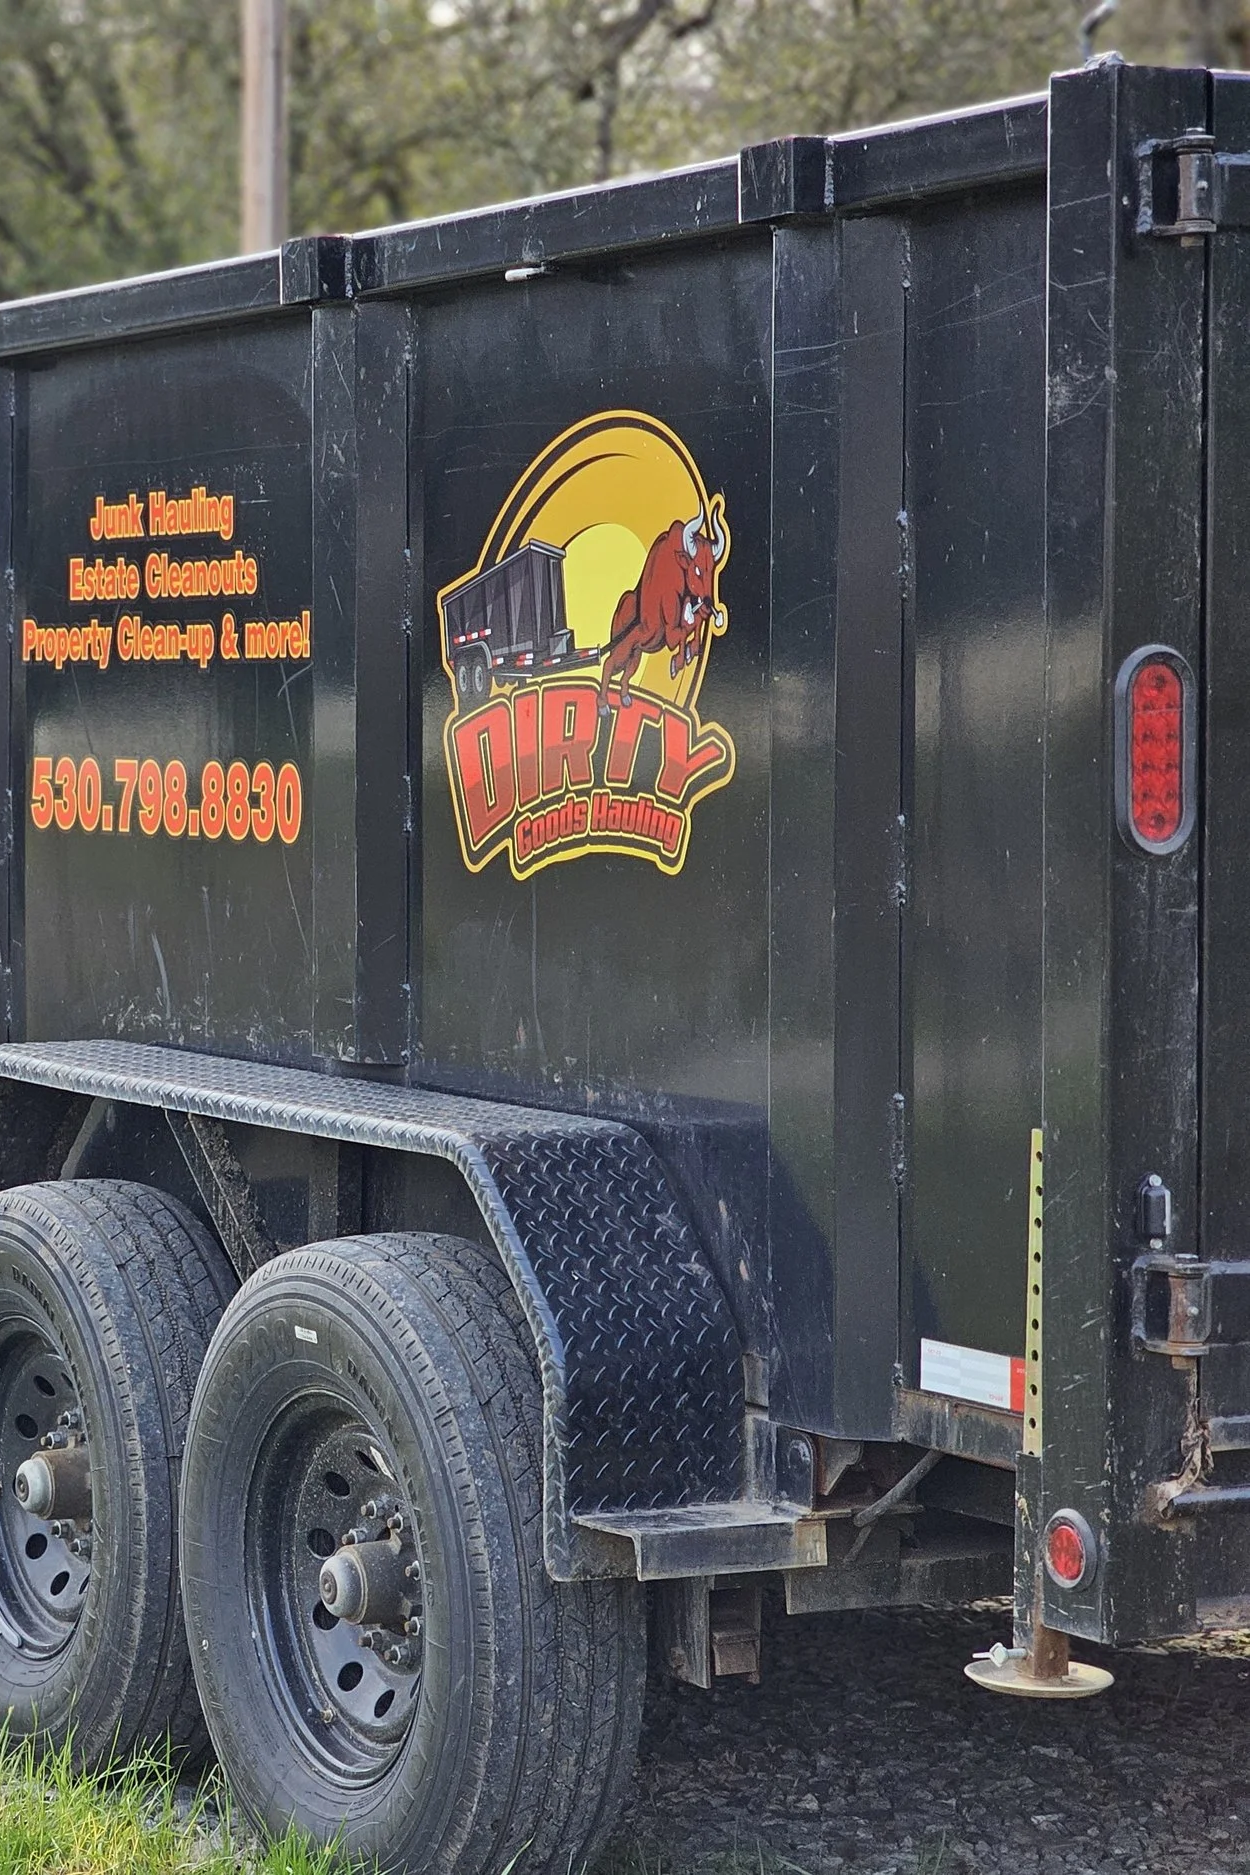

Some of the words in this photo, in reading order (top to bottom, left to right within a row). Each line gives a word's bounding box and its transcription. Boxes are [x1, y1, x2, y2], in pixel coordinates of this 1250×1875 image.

[90, 495, 144, 540] Junk
[148, 487, 234, 540] Hauling
[69, 557, 140, 601] Estate
[145, 551, 258, 599] Cleanouts
[22, 619, 113, 670] Property
[117, 615, 215, 668] Clean-up
[221, 613, 240, 659] &
[245, 610, 311, 659] more!
[453, 682, 723, 848] DIRTY
[31, 757, 302, 844] 530.798.8830
[516, 794, 588, 859] Goods
[590, 791, 683, 853] Hauling
